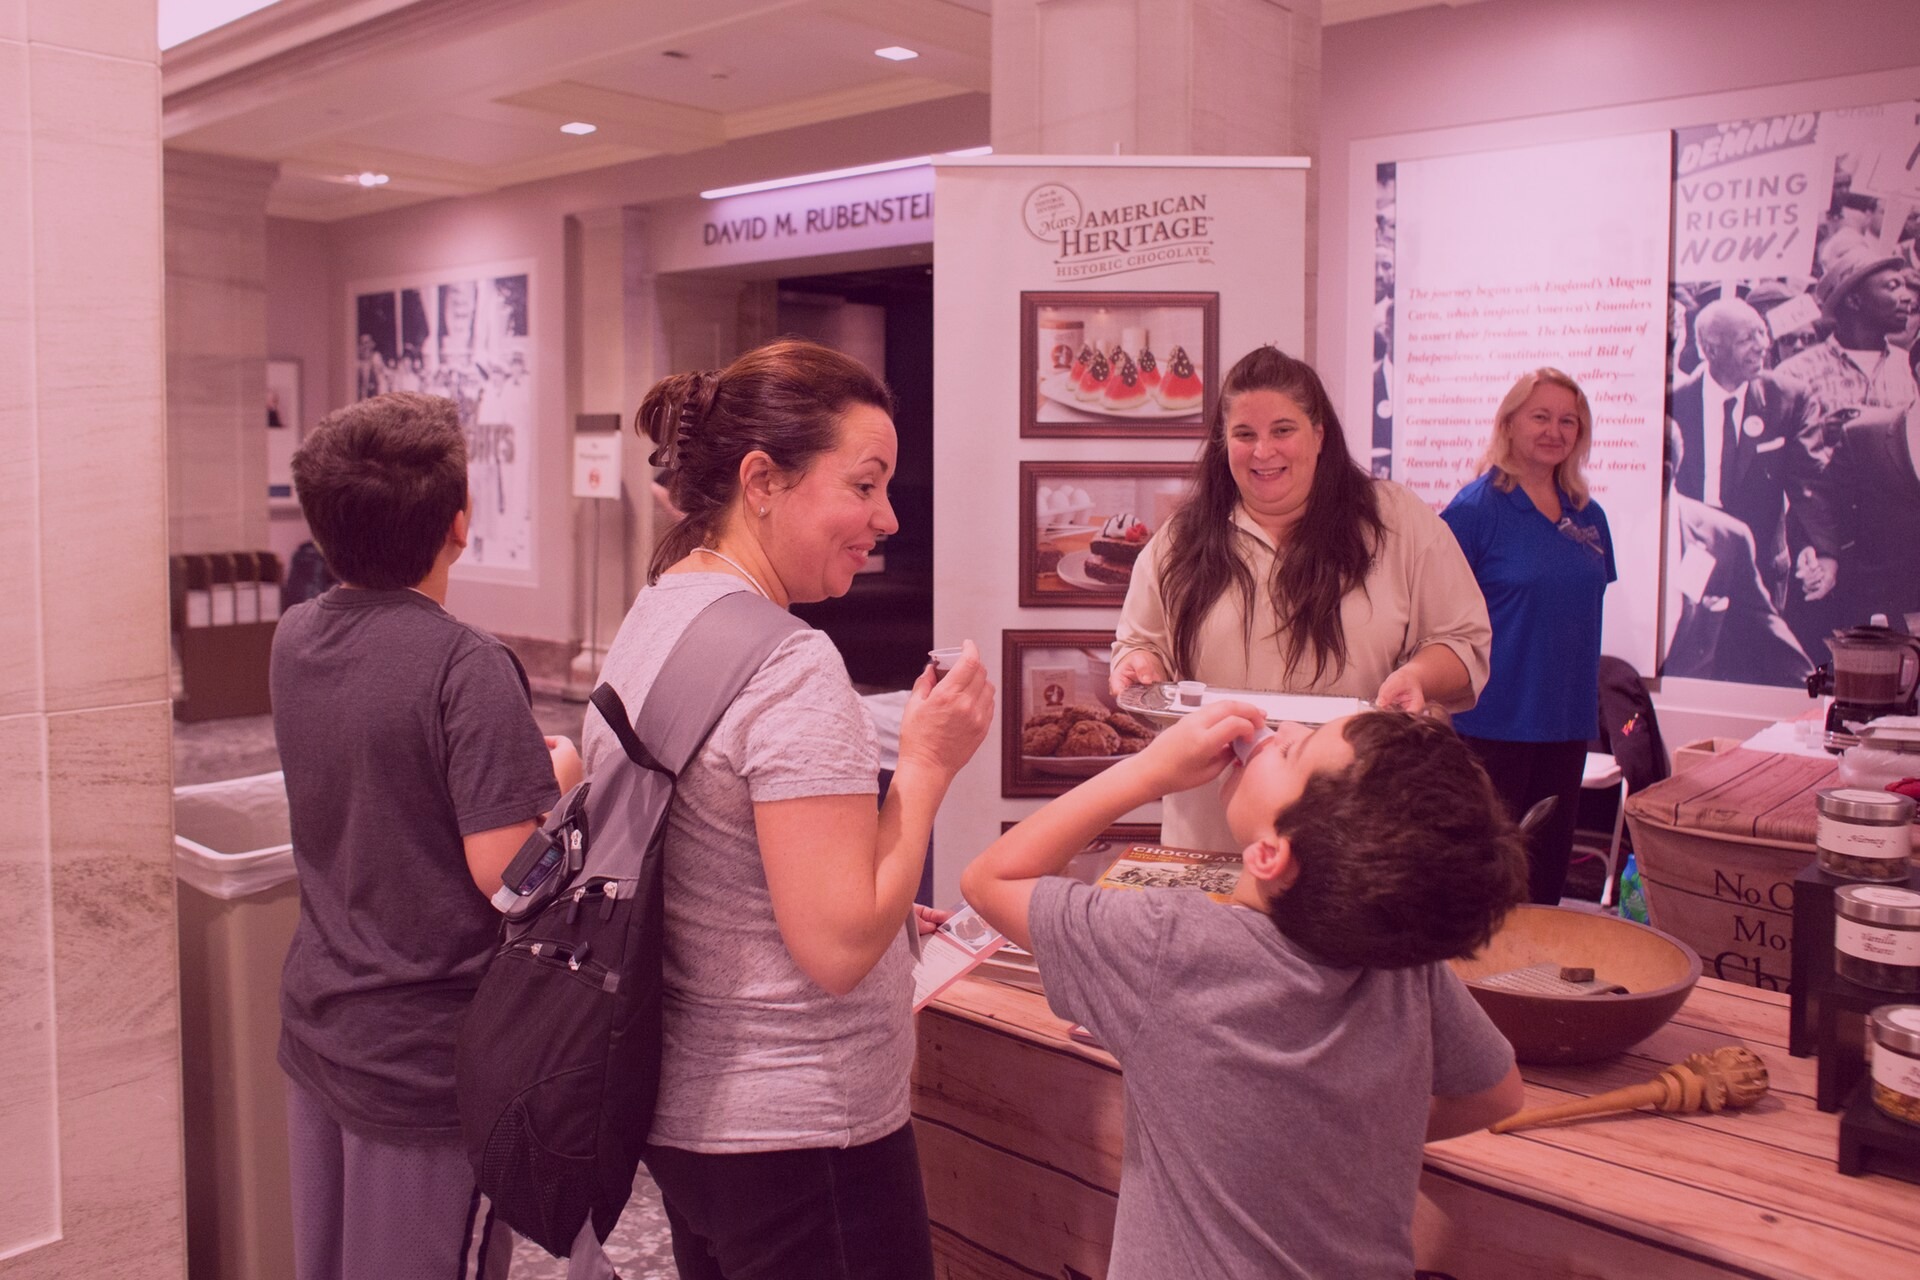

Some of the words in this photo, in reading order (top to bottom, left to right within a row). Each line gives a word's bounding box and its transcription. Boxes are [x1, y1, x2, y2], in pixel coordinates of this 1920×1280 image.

[1678, 112, 1816, 175] DEMAND
[1681, 172, 1808, 204] VOTING
[703, 216, 767, 247] DAVID
[774, 213, 798, 238] M.
[805, 193, 932, 234] RUBENSTEI
[1084, 194, 1207, 229] AMERICAN
[1686, 203, 1799, 232] RIGHTS
[1037, 215, 1077, 237] Mars
[1060, 216, 1209, 258] HERITAGE
[1680, 226, 1800, 266] NOW!
[1056, 259, 1123, 278] HISTORIC
[1127, 245, 1210, 268] CHOCOLATE
[1408, 287, 1429, 301] The
[1431, 286, 1472, 302] journey
[1476, 285, 1511, 298] begins
[1515, 281, 1540, 295] with
[1544, 277, 1602, 294] England's
[1607, 276, 1652, 291] Magna
[1446, 306, 1479, 320] which
[1595, 298, 1652, 312] Founders
[1455, 328, 1479, 341] their
[1537, 325, 1556, 337] The
[1561, 323, 1632, 336] Declaration
[1635, 320, 1650, 336] of
[1567, 346, 1592, 358] and
[1597, 344, 1619, 358] Bill
[1622, 344, 1636, 360] of
[1406, 396, 1425, 405] are
[1428, 392, 1483, 405] milestones
[1405, 415, 1472, 427] Generations
[1595, 413, 1646, 428] freedom
[1405, 435, 1427, 448] and
[1430, 435, 1473, 451] equality
[1451, 457, 1463, 472] of
[1607, 458, 1647, 472] stories
[1405, 477, 1430, 490] from
[1434, 478, 1450, 489] the
[1132, 846, 1242, 863] CHOCOLAT
[1714, 869, 1760, 905] No
[1733, 915, 1792, 951] Mo
